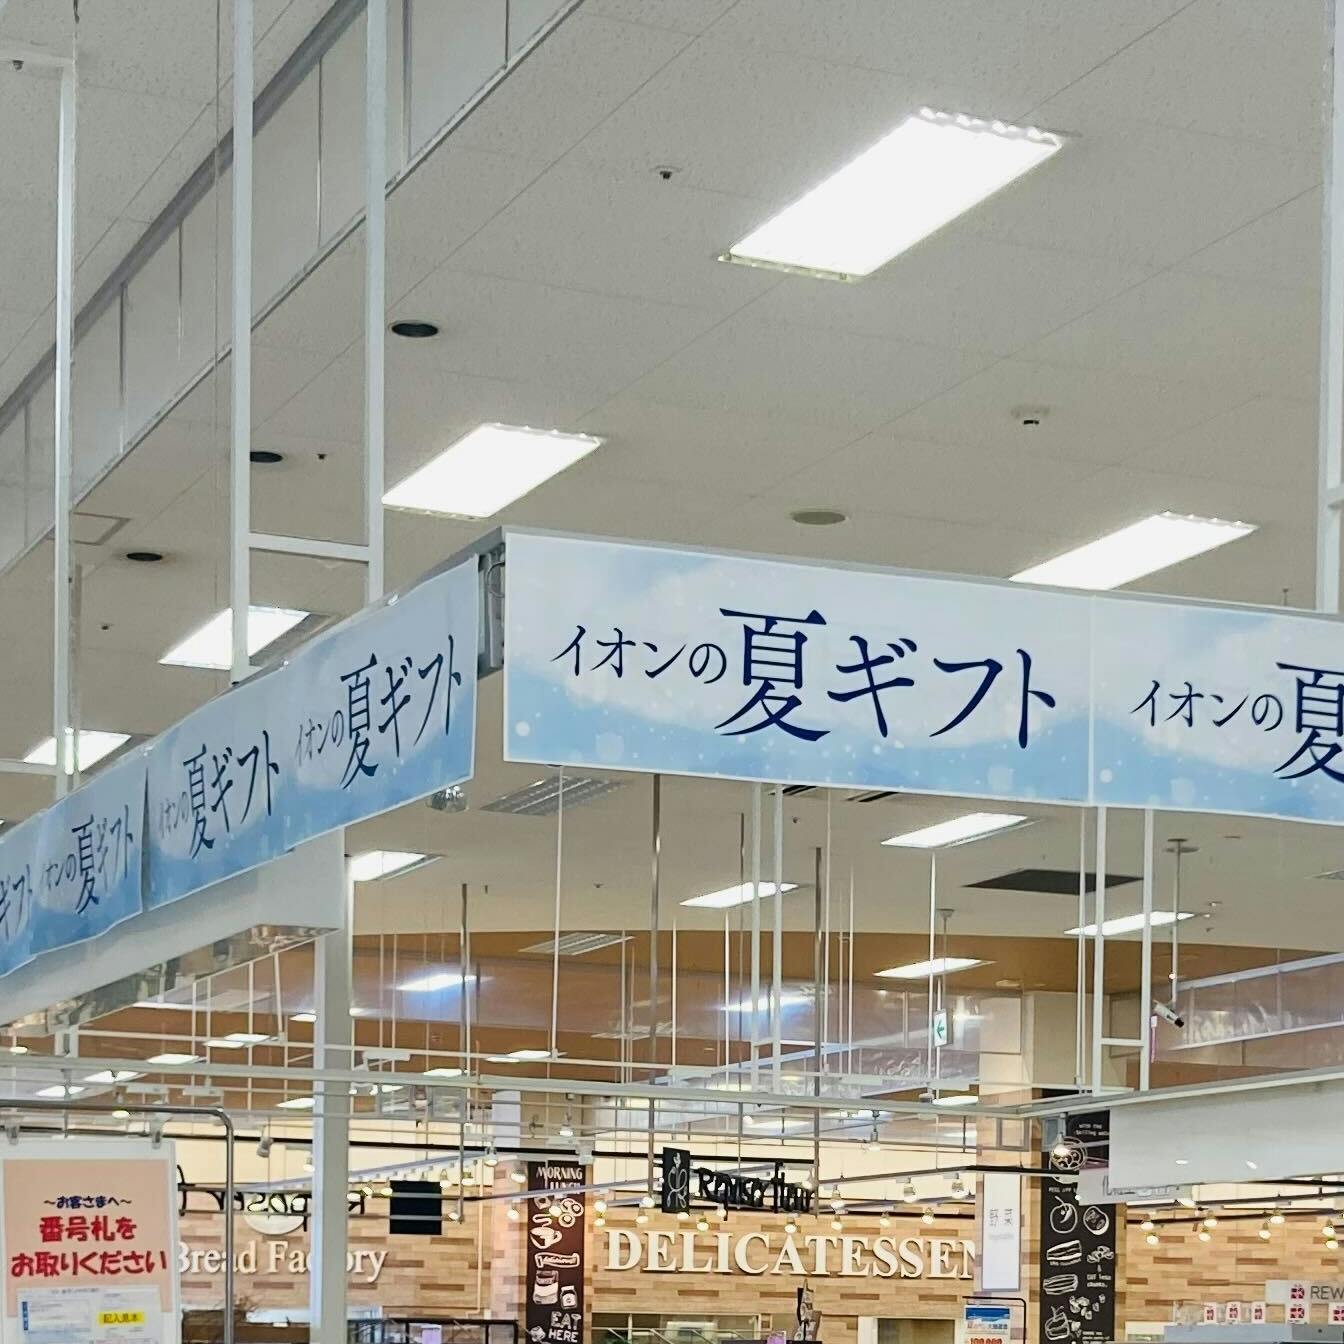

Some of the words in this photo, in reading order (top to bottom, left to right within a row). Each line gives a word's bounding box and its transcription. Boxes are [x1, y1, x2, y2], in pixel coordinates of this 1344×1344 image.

[552, 606, 1057, 750] イオンの夏ギフト
[295, 634, 463, 790] イオンの夏ギフト
[536, 1166, 583, 1180] MORNING
[39, 1216, 137, 1243] 番号札を
[10, 1251, 167, 1278] お取りください
[551, 1311, 582, 1330] EAT
[548, 1329, 579, 1343] HERE
